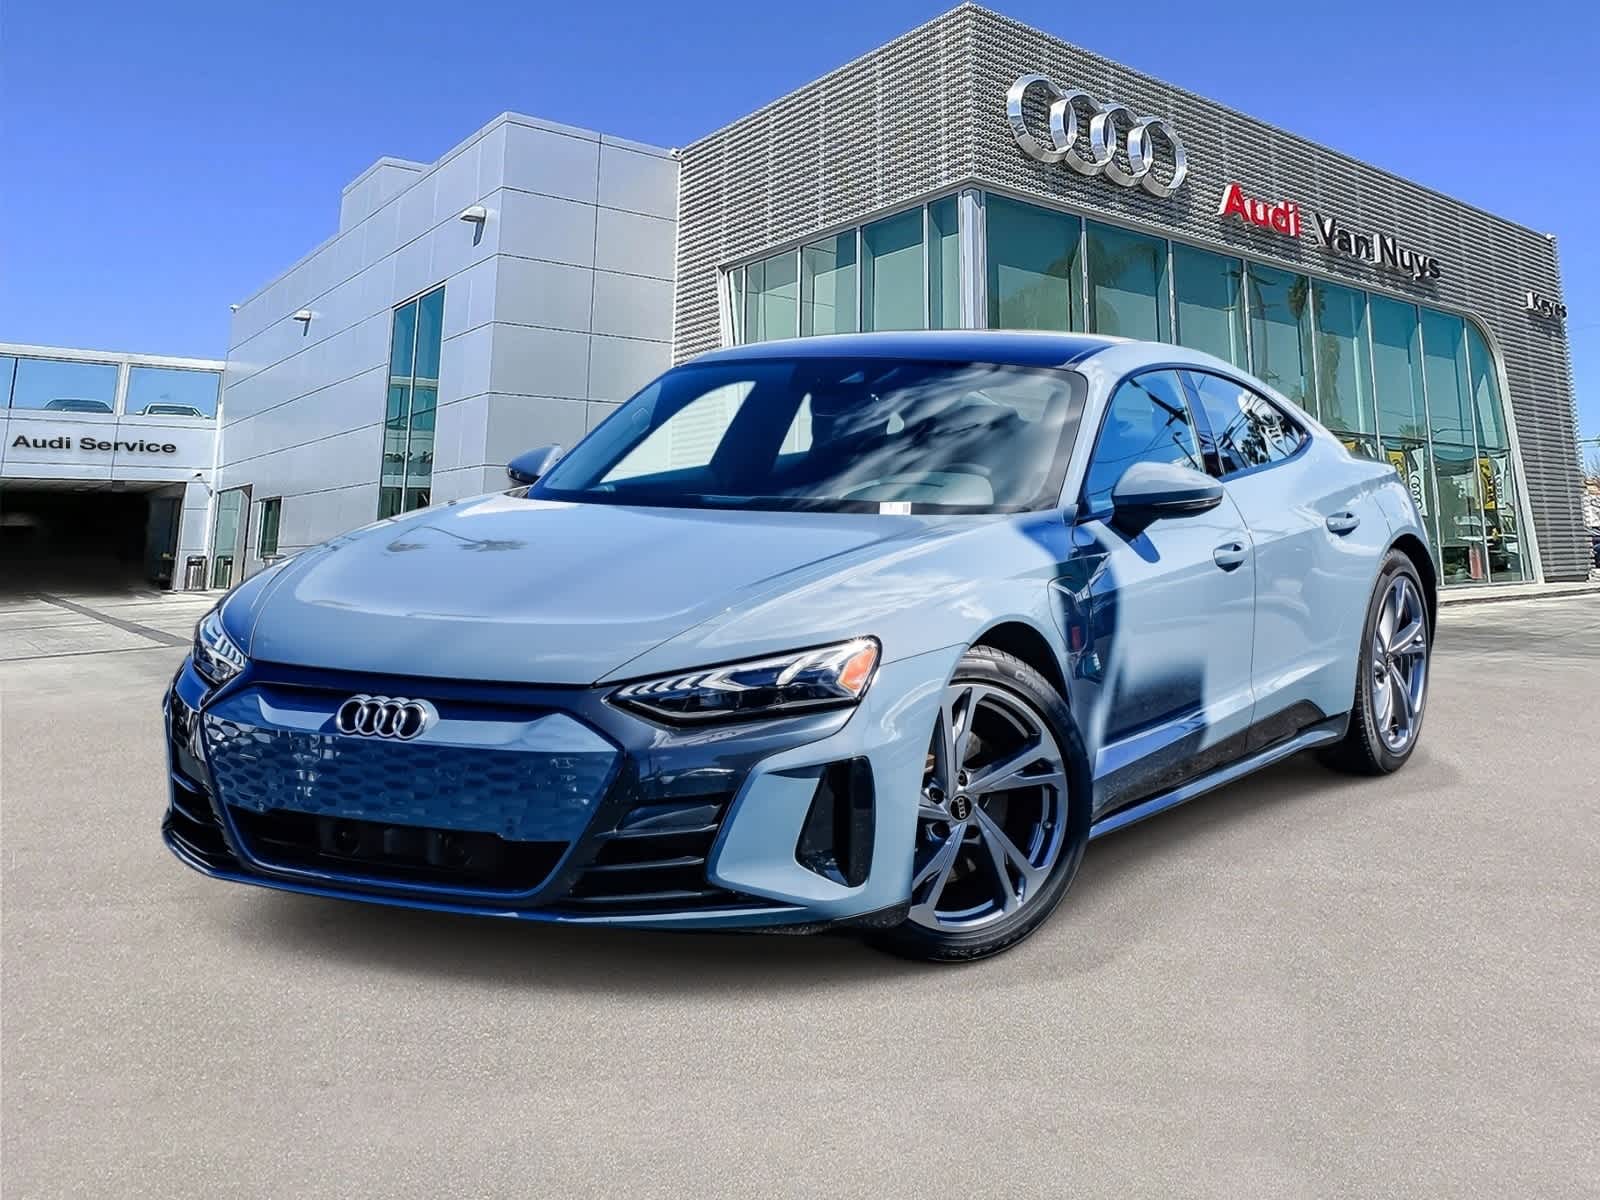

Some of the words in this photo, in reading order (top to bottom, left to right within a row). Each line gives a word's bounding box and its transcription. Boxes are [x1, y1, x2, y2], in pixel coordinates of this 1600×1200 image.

[1218, 182, 1302, 238] Audi
[1311, 212, 1373, 259] Van
[1373, 232, 1442, 280] Nuys
[12, 435, 72, 450] Audi
[79, 437, 177, 454] Service
